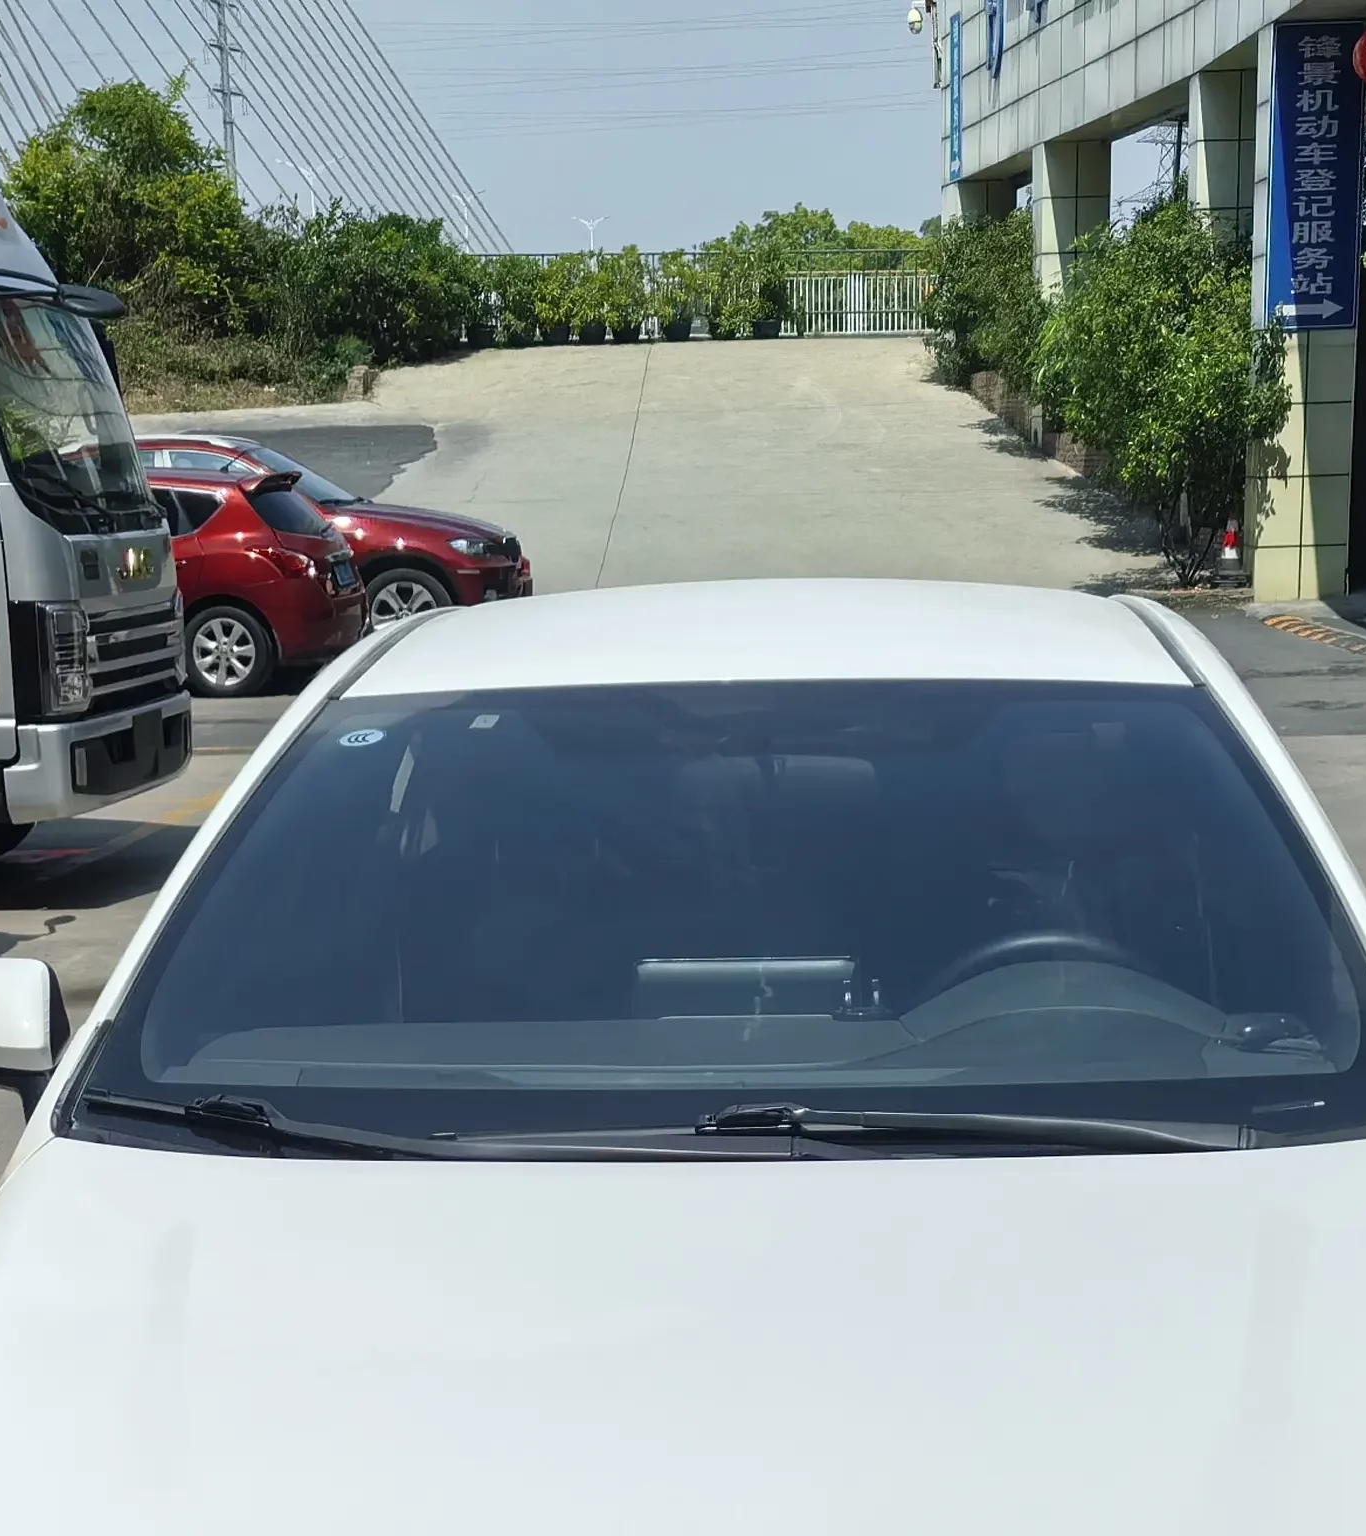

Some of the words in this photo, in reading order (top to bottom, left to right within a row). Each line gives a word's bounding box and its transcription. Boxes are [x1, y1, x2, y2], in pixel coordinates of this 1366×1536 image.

[1291, 35, 1342, 295] 锋景机动车登记服务站
